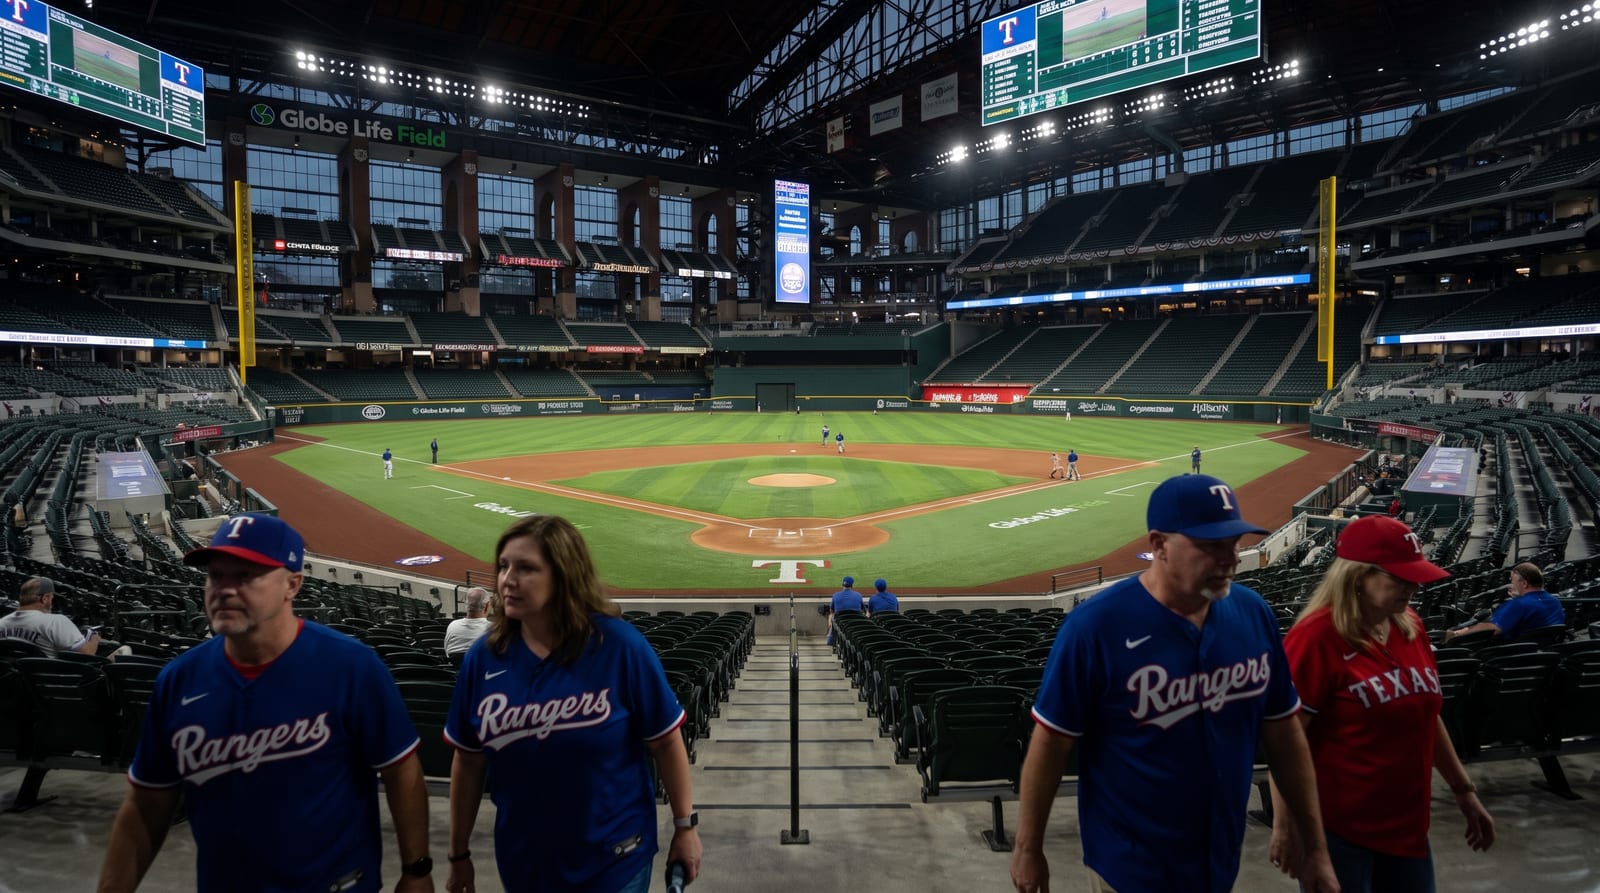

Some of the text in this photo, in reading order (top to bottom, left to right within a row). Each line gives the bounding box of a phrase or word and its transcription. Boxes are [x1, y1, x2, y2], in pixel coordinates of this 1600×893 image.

[999, 17, 1018, 44] T
[174, 62, 191, 84] T
[279, 109, 446, 148] Globe Life Field
[1209, 484, 1234, 511] T
[228, 517, 255, 539] T
[988, 515, 1051, 529] Globe
[1404, 532, 1421, 554] T
[752, 560, 831, 584] T
[1127, 652, 1271, 729] Rangers
[1348, 666, 1443, 709] TEXAS
[477, 688, 611, 750] Rangers
[172, 712, 331, 785] Rangers
